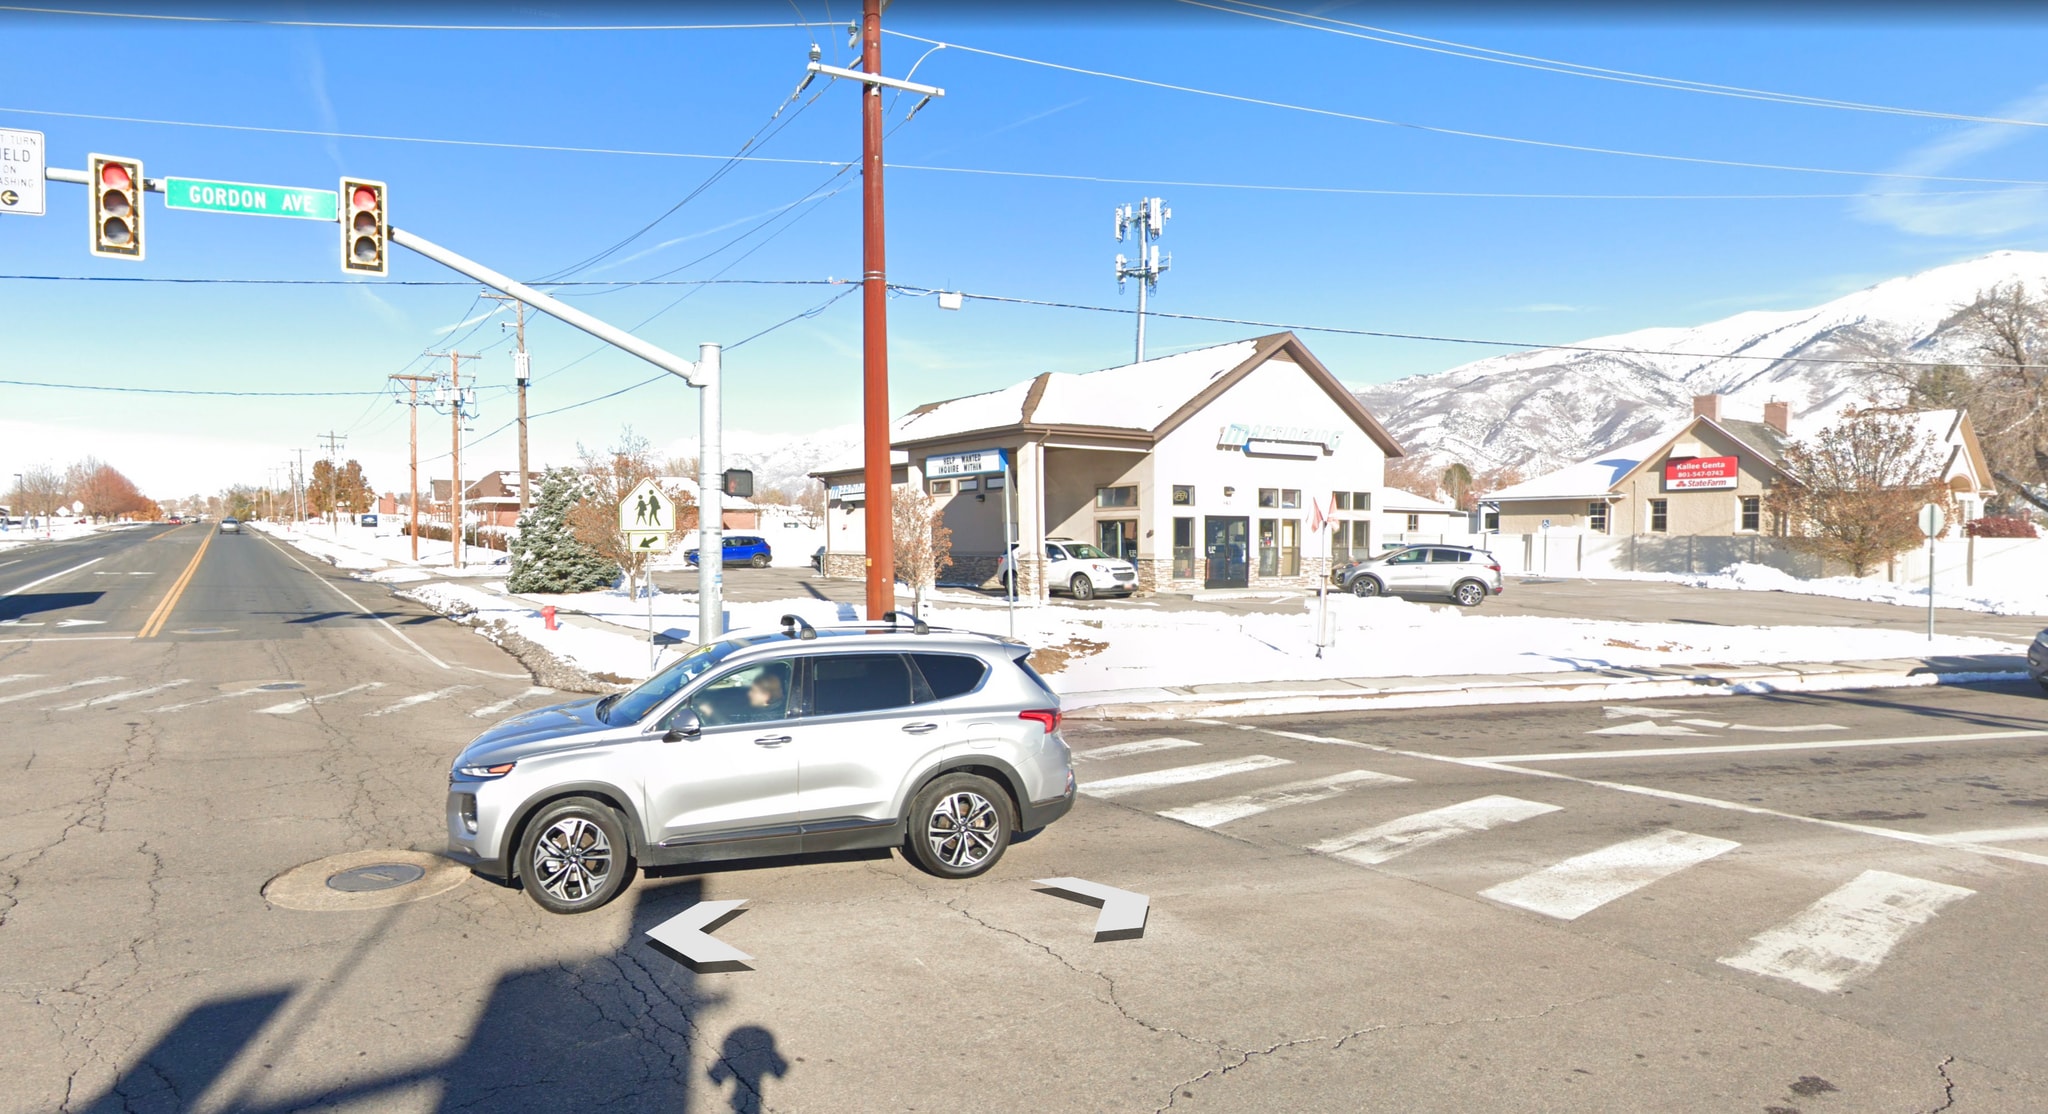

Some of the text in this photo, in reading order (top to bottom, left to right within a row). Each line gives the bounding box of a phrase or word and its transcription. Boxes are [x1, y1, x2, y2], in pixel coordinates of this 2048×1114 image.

[11, 135, 36, 146] TURN
[0, 148, 31, 162] IELD
[3, 164, 16, 174] ON
[0, 176, 34, 188] ASHING
[189, 185, 316, 213] GORDON AVE
[943, 453, 981, 465] HELP WANTED
[938, 463, 982, 474] INQUIRE WITHIN
